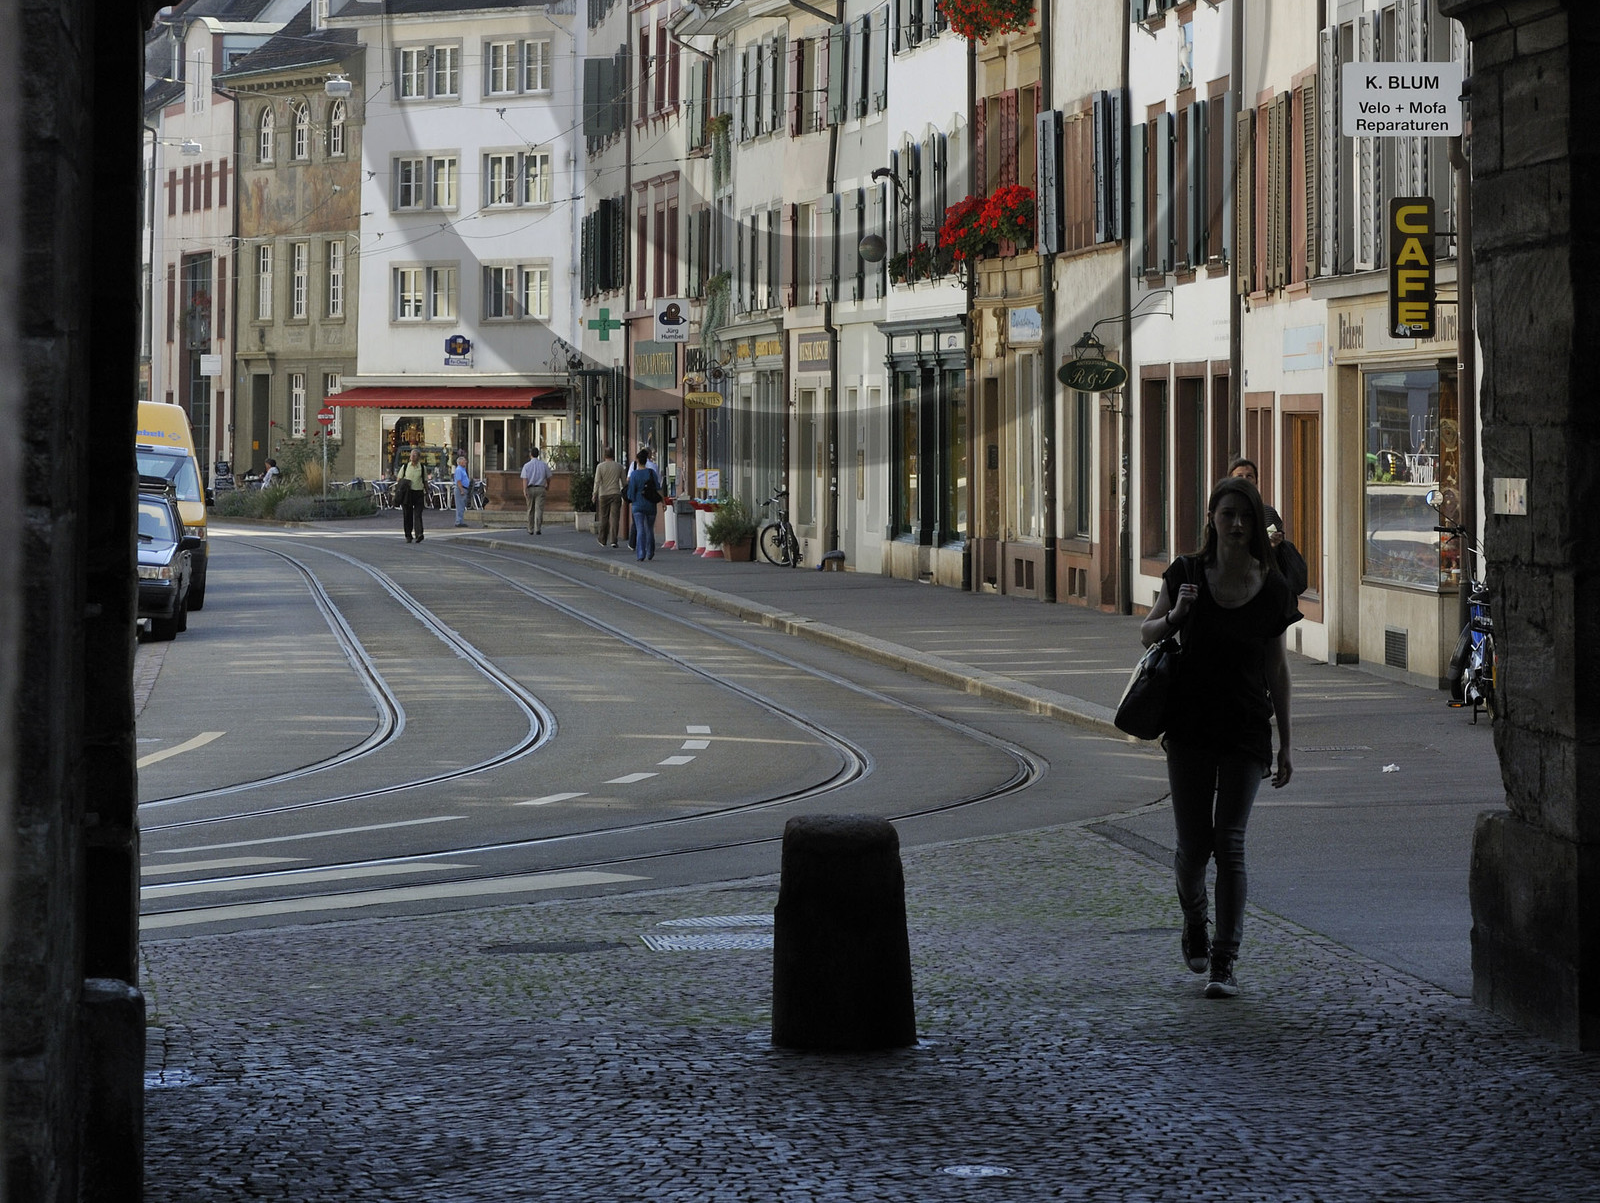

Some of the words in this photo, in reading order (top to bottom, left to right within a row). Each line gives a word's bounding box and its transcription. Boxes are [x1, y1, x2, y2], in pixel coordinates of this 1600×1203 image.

[1366, 76, 1382, 89] K.
[1388, 76, 1439, 89] BLUM
[1359, 102, 1391, 114] Velo
[1410, 102, 1446, 114] Mofa
[1356, 119, 1449, 133] Reparaturen
[1396, 205, 1430, 330] CAFE
[1338, 312, 1364, 350] Bäckerei
